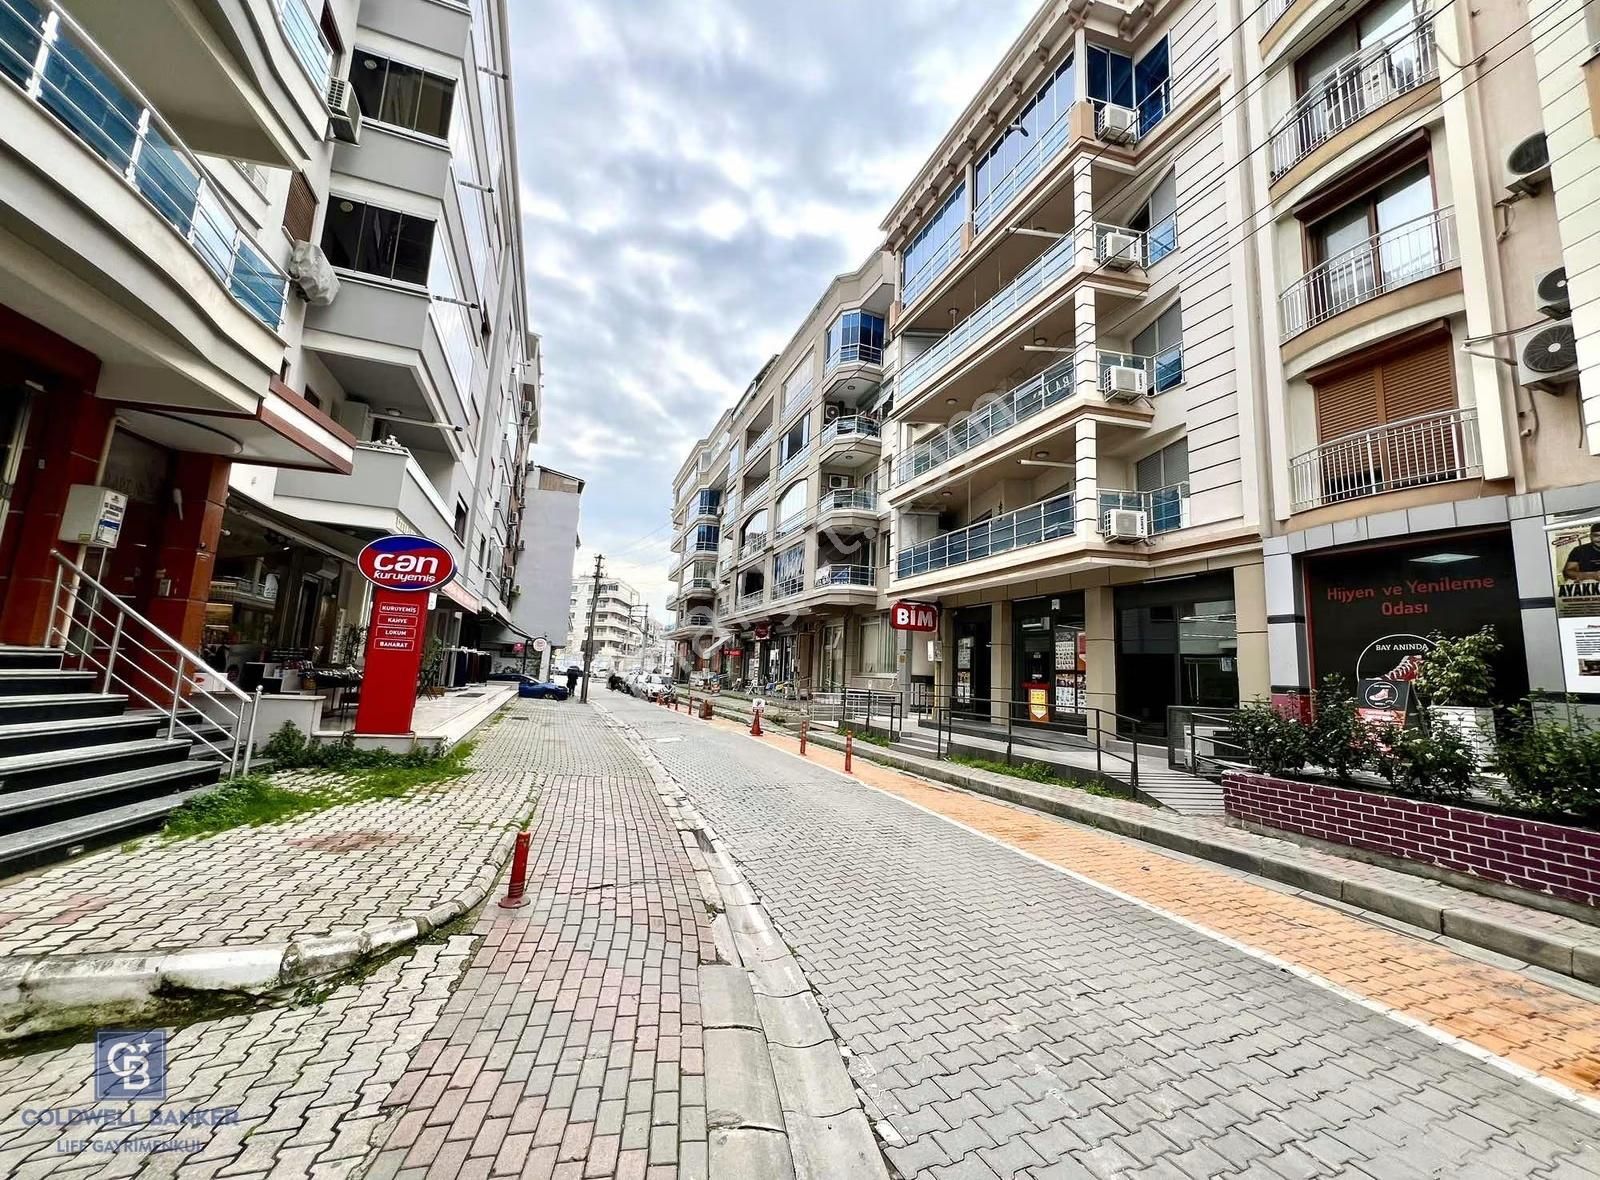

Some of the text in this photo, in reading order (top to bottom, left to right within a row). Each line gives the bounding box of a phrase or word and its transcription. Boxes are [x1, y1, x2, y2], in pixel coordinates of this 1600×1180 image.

[374, 570, 436, 582] kuruyemiş
[1326, 577, 1495, 603] Hijyen ve Yenileme
[382, 605, 417, 613] KURUYEMİŞ
[897, 605, 933, 627] BİM
[1393, 643, 1429, 652] ANINDA
